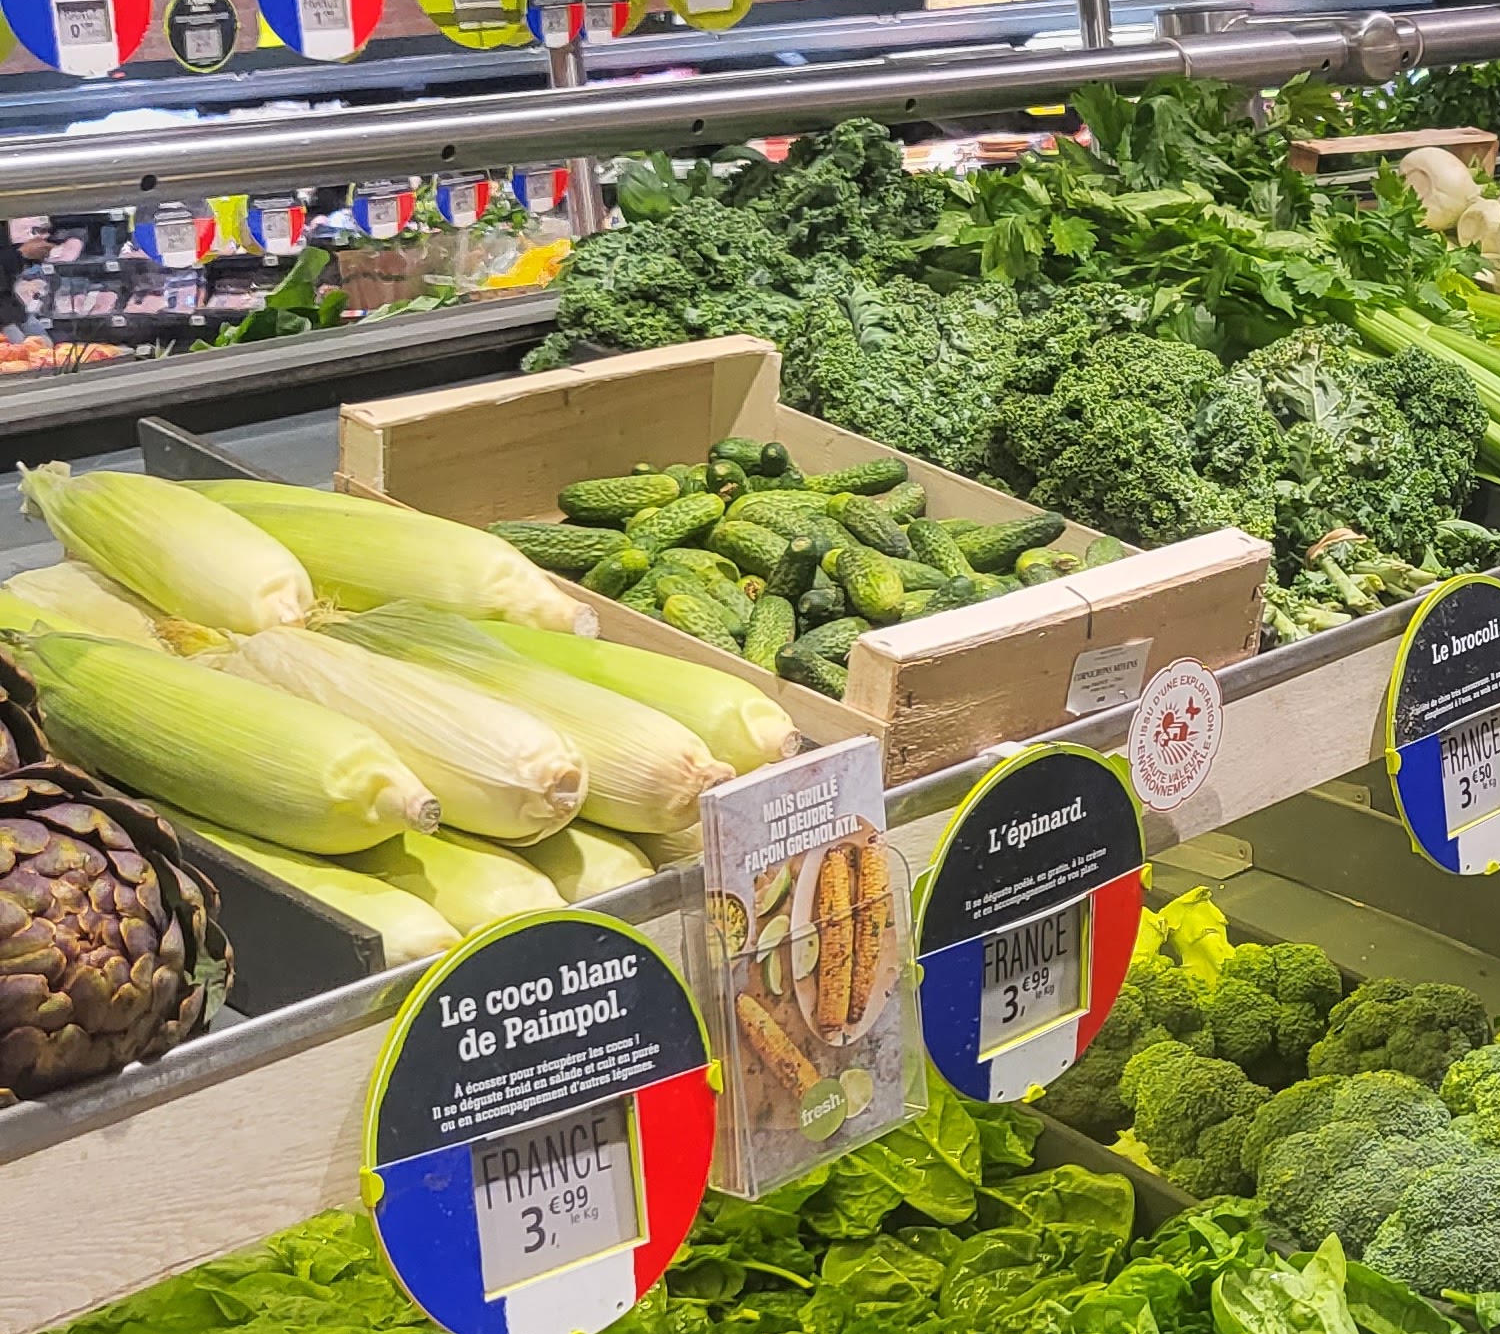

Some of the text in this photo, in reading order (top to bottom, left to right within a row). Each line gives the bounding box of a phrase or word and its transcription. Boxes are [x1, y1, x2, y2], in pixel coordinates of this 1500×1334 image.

[1431, 643, 1449, 665] Le
[1140, 707, 1154, 737] ISSU
[1153, 677, 1179, 706] D'UNE
[1179, 674, 1215, 732] EXPLOITATION
[1137, 741, 1212, 797] ENVIRONNEMENTALE
[1146, 749, 1201, 784] HAUTE VALEUR
[763, 774, 839, 823] MAÏS GRILLÉ
[770, 801, 835, 842] AU BEURRE
[988, 796, 1087, 854] L'épinard.
[744, 815, 863, 874] FAÇON GREMOLATA.
[965, 900, 973, 911] Il
[972, 898, 982, 908] se
[983, 886, 1013, 904] déguste
[1036, 872, 1047, 883] en
[1077, 855, 1085, 865] la
[1085, 847, 1107, 863] crème
[973, 910, 982, 920] et
[982, 906, 993, 917] en
[994, 881, 1057, 912] accompagnement
[1057, 875, 1067, 888] de
[1067, 871, 1080, 882] vos
[983, 912, 1067, 989] FRANCE
[439, 954, 638, 1028] Le coco blanc
[458, 989, 628, 1062] de Paimpol.
[432, 1042, 661, 1120] Il se déguste froid en salade et cuit en purée
[464, 1072, 507, 1096] écosser
[509, 1067, 535, 1085] pour
[536, 1051, 587, 1075] récupérer
[588, 1044, 605, 1058] les
[605, 1038, 634, 1055] cocos
[440, 1060, 656, 1133] ou en accompagnement d'autres légumes.
[801, 1093, 845, 1127] fresh.
[481, 1118, 612, 1210] FRANCE
[570, 1207, 599, 1225] le Kg
